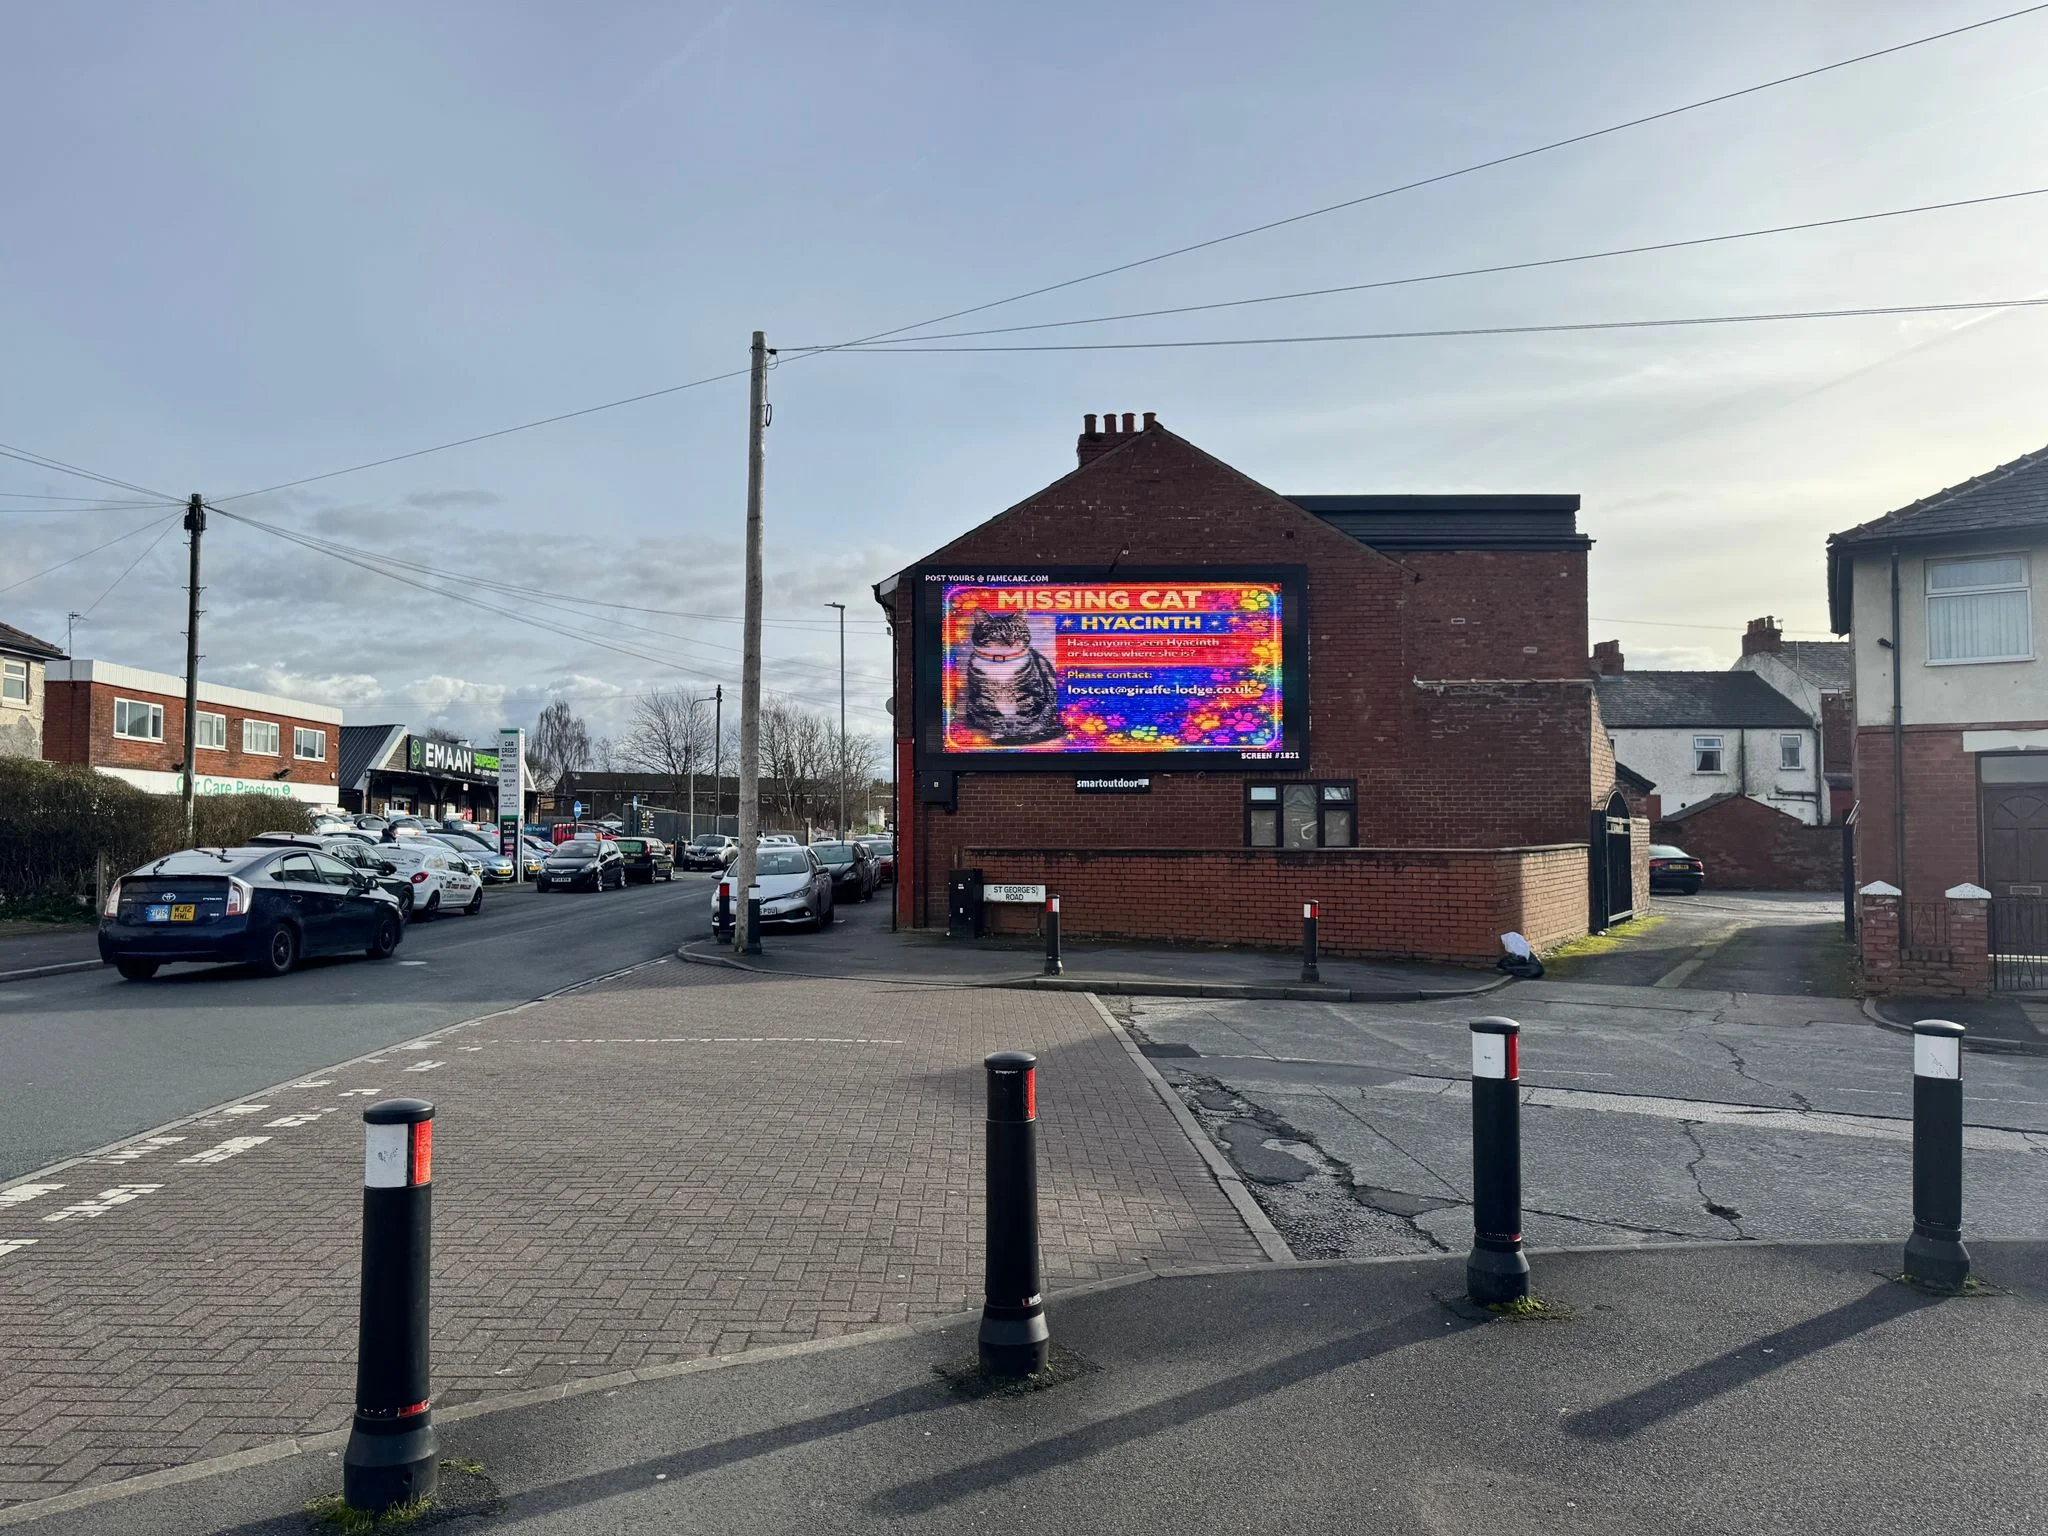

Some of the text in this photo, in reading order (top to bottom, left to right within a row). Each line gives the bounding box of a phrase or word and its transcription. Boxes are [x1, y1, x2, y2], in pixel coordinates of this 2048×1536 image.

[925, 574, 1049, 583] POST YOURS @ FAMECAKE.COM
[998, 590, 1202, 609] MISSING CAT
[1081, 616, 1201, 630] HYACINTH
[1067, 638, 1089, 647] Has
[1092, 639, 1134, 648] anyone
[1166, 638, 1220, 648] Hyacinth
[1082, 649, 1119, 657] knows
[1121, 649, 1157, 657] where
[1158, 649, 1180, 657] she
[1180, 649, 1197, 657] is?
[1067, 671, 1153, 679] Please contact:
[1067, 685, 1253, 696] lostcat@giraffe-lodge.co.uk
[425, 742, 472, 774] EMAAN
[1241, 752, 1273, 760] SCREEN
[176, 776, 279, 799] Cr Care Preston
[1076, 778, 1139, 789] smartoutdoor
